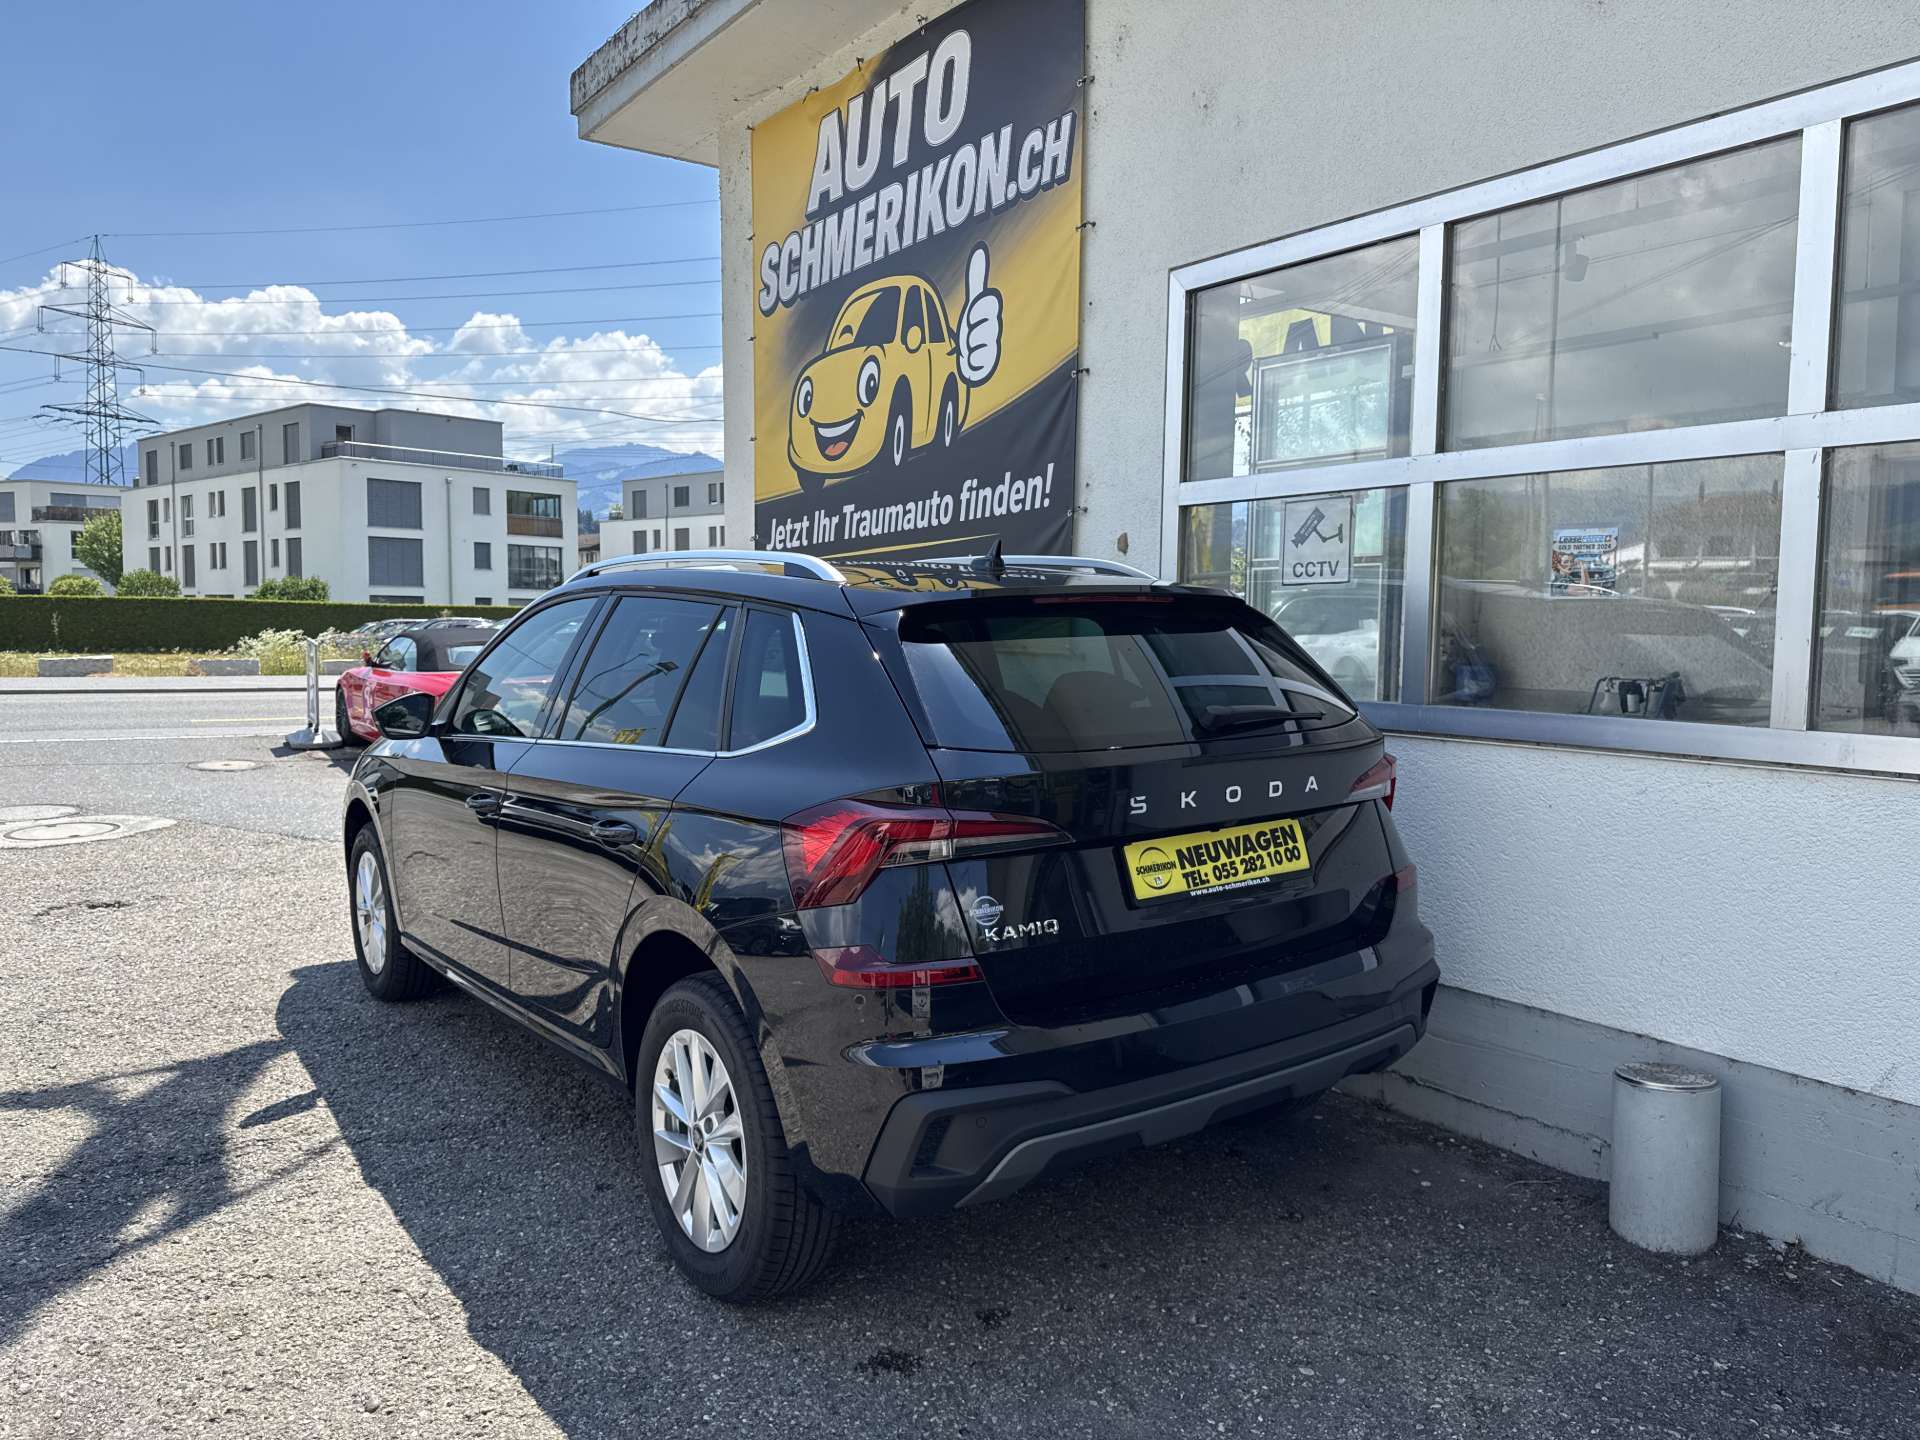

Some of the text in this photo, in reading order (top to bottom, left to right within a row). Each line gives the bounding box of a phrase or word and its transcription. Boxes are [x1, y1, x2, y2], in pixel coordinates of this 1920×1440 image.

[805, 29, 972, 219] AUTO
[759, 112, 1075, 312] SCHMERIKON.CH
[766, 463, 1054, 551] Jetzt Ihr Traumauto finden!
[1292, 560, 1339, 577] CCTV
[1130, 776, 1319, 815] SKODA
[1136, 860, 1177, 875] SCHMERIKON
[1175, 824, 1298, 870] NEUWAGEN
[1182, 845, 1301, 889] TEL: 055 282 10 00
[985, 919, 1060, 942] KAMIQ
